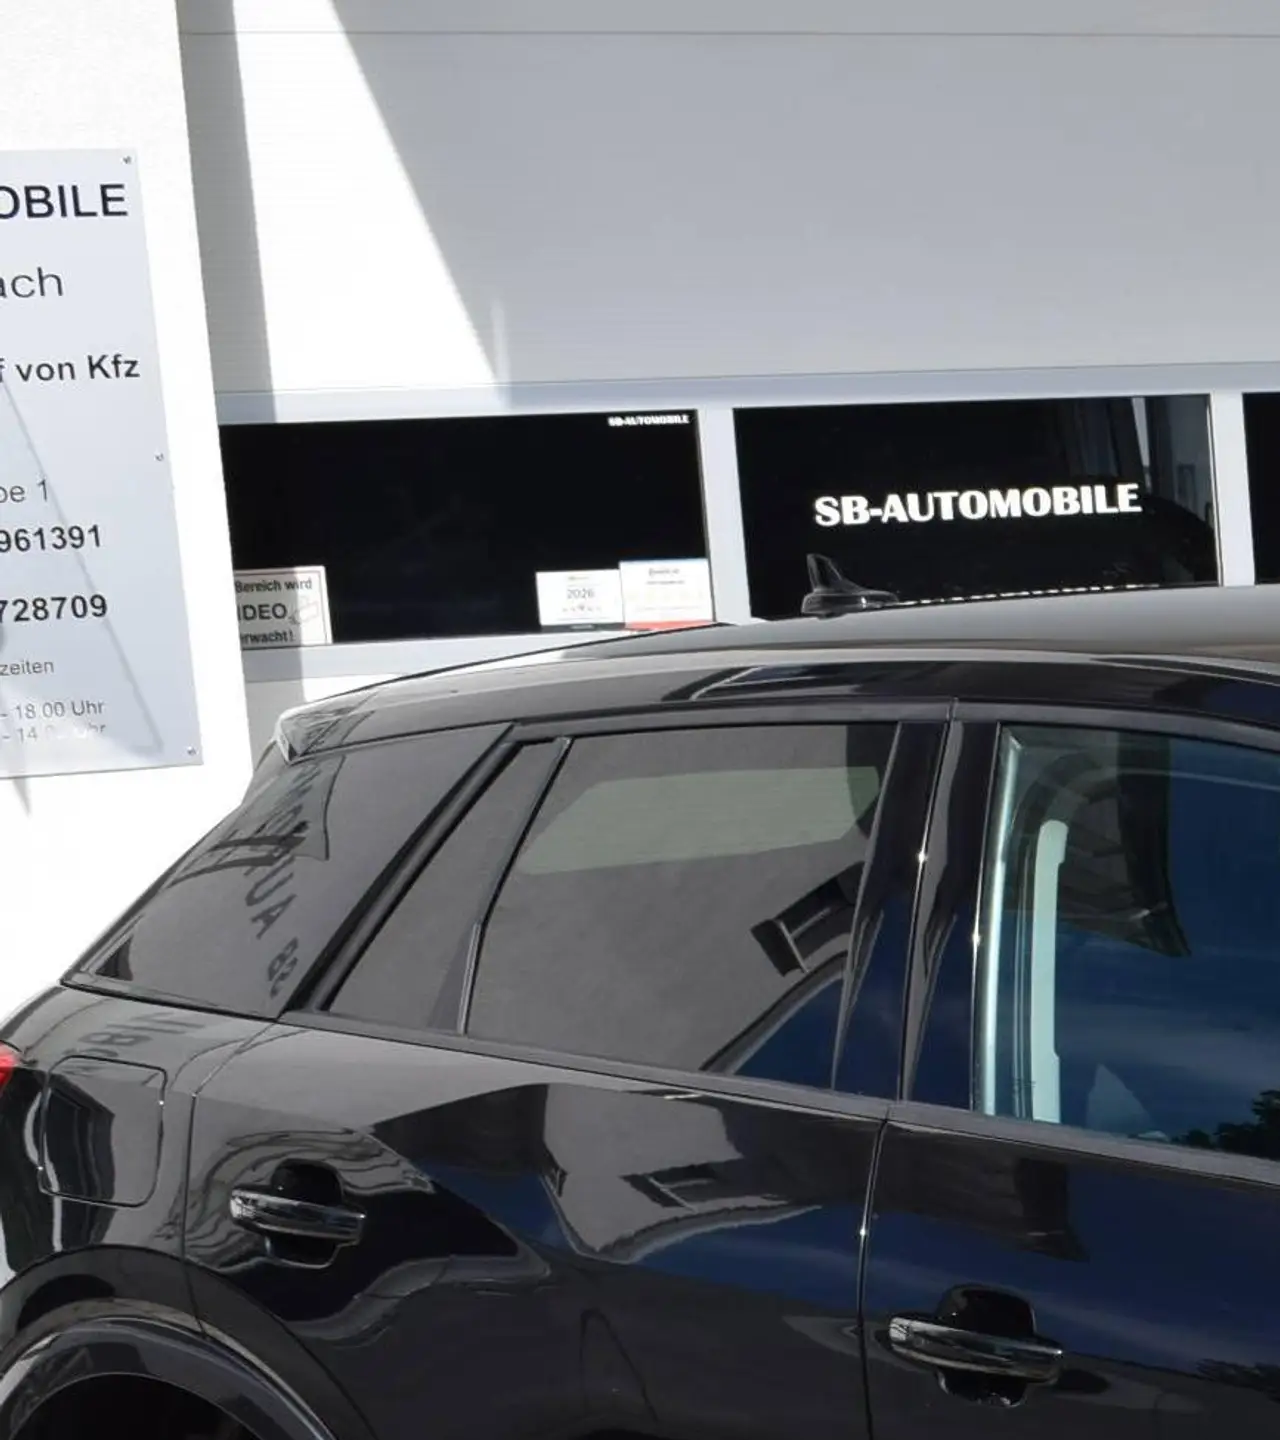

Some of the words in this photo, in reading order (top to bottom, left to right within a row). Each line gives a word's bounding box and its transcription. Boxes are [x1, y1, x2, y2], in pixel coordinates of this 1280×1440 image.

[15, 361, 76, 382] von
[87, 353, 140, 380] Kfz
[37, 479, 47, 502] 1
[815, 483, 1142, 526] SB-AUTOMOBILE
[285, 578, 313, 591] wird
[70, 699, 104, 716] Uhr
